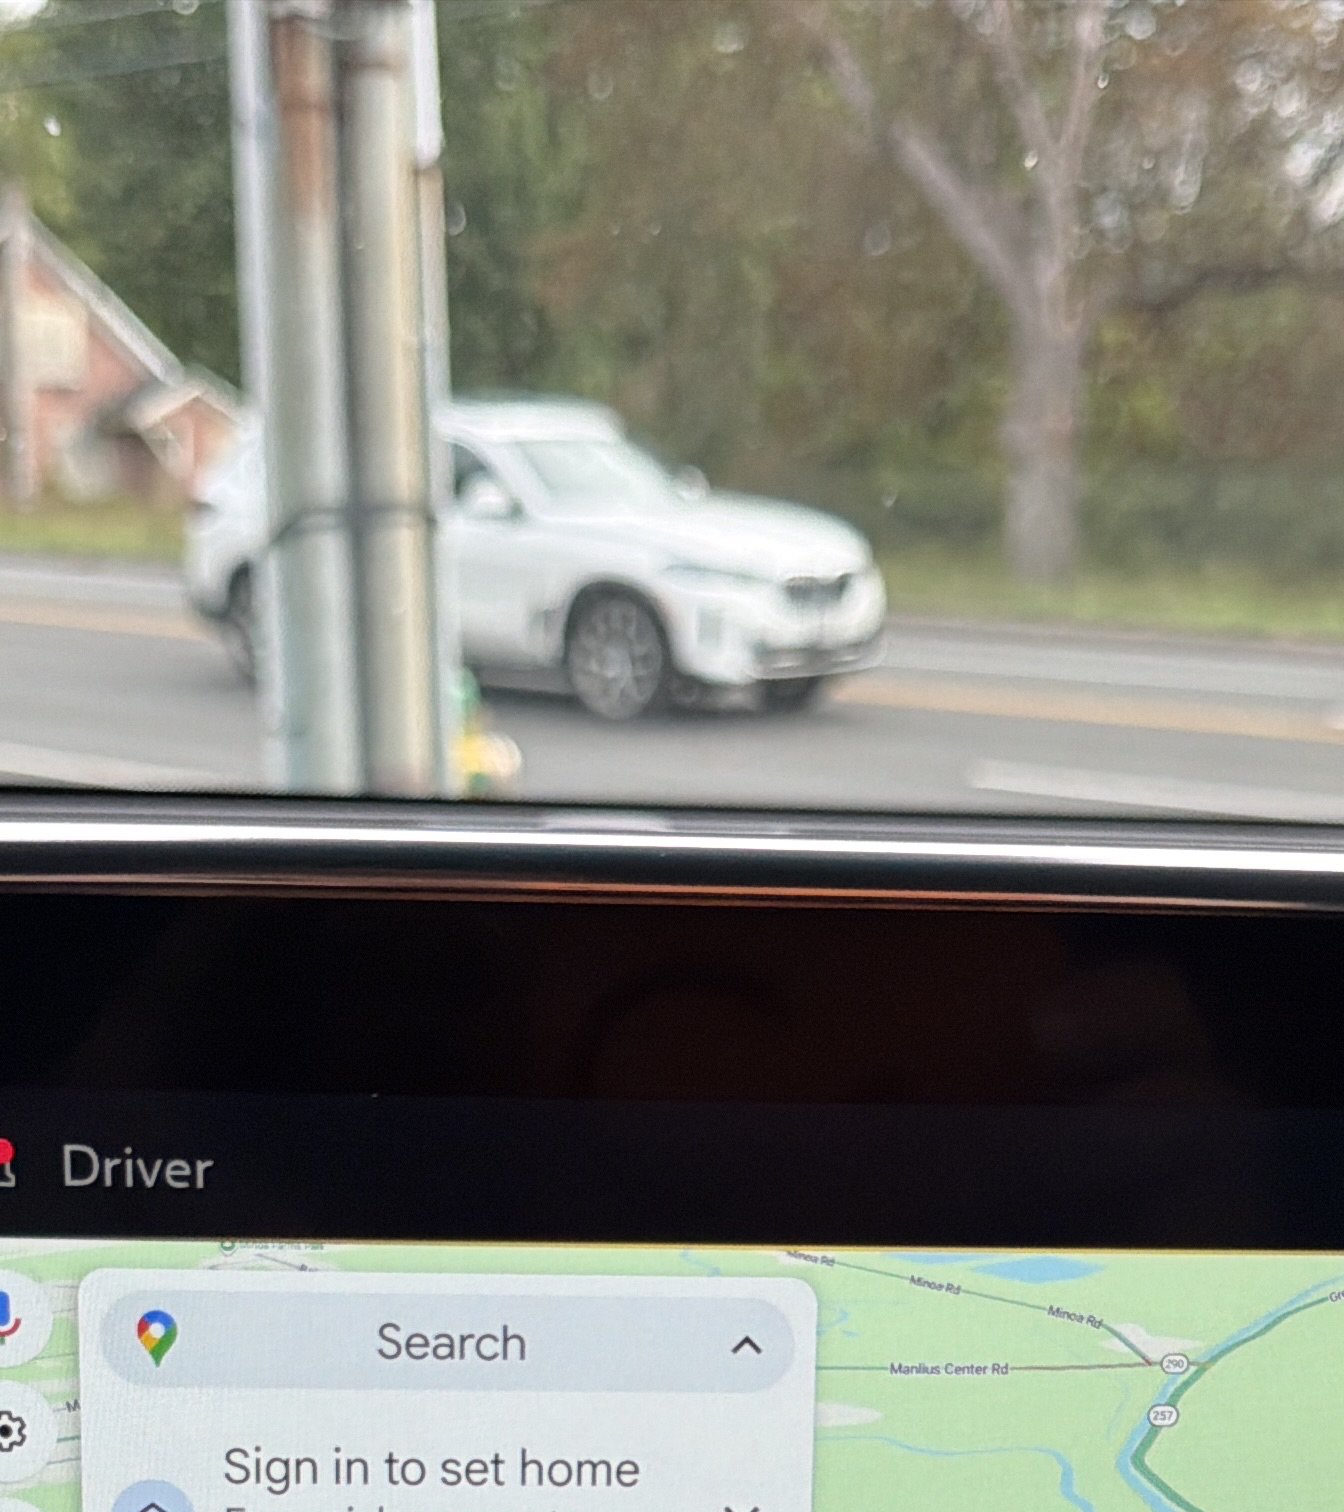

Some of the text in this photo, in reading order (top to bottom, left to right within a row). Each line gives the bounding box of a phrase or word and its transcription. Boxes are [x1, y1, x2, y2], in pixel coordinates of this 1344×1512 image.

[63, 1144, 214, 1189] Driver
[909, 1275, 962, 1295] Minoa Rd
[1047, 1305, 1104, 1329] Minoa Rd
[376, 1322, 527, 1361] Search
[889, 1362, 1009, 1375] Manlius Center Rd
[1164, 1358, 1185, 1370] 290
[1152, 1410, 1174, 1422] 257
[223, 1446, 641, 1495] Sign in to set home
